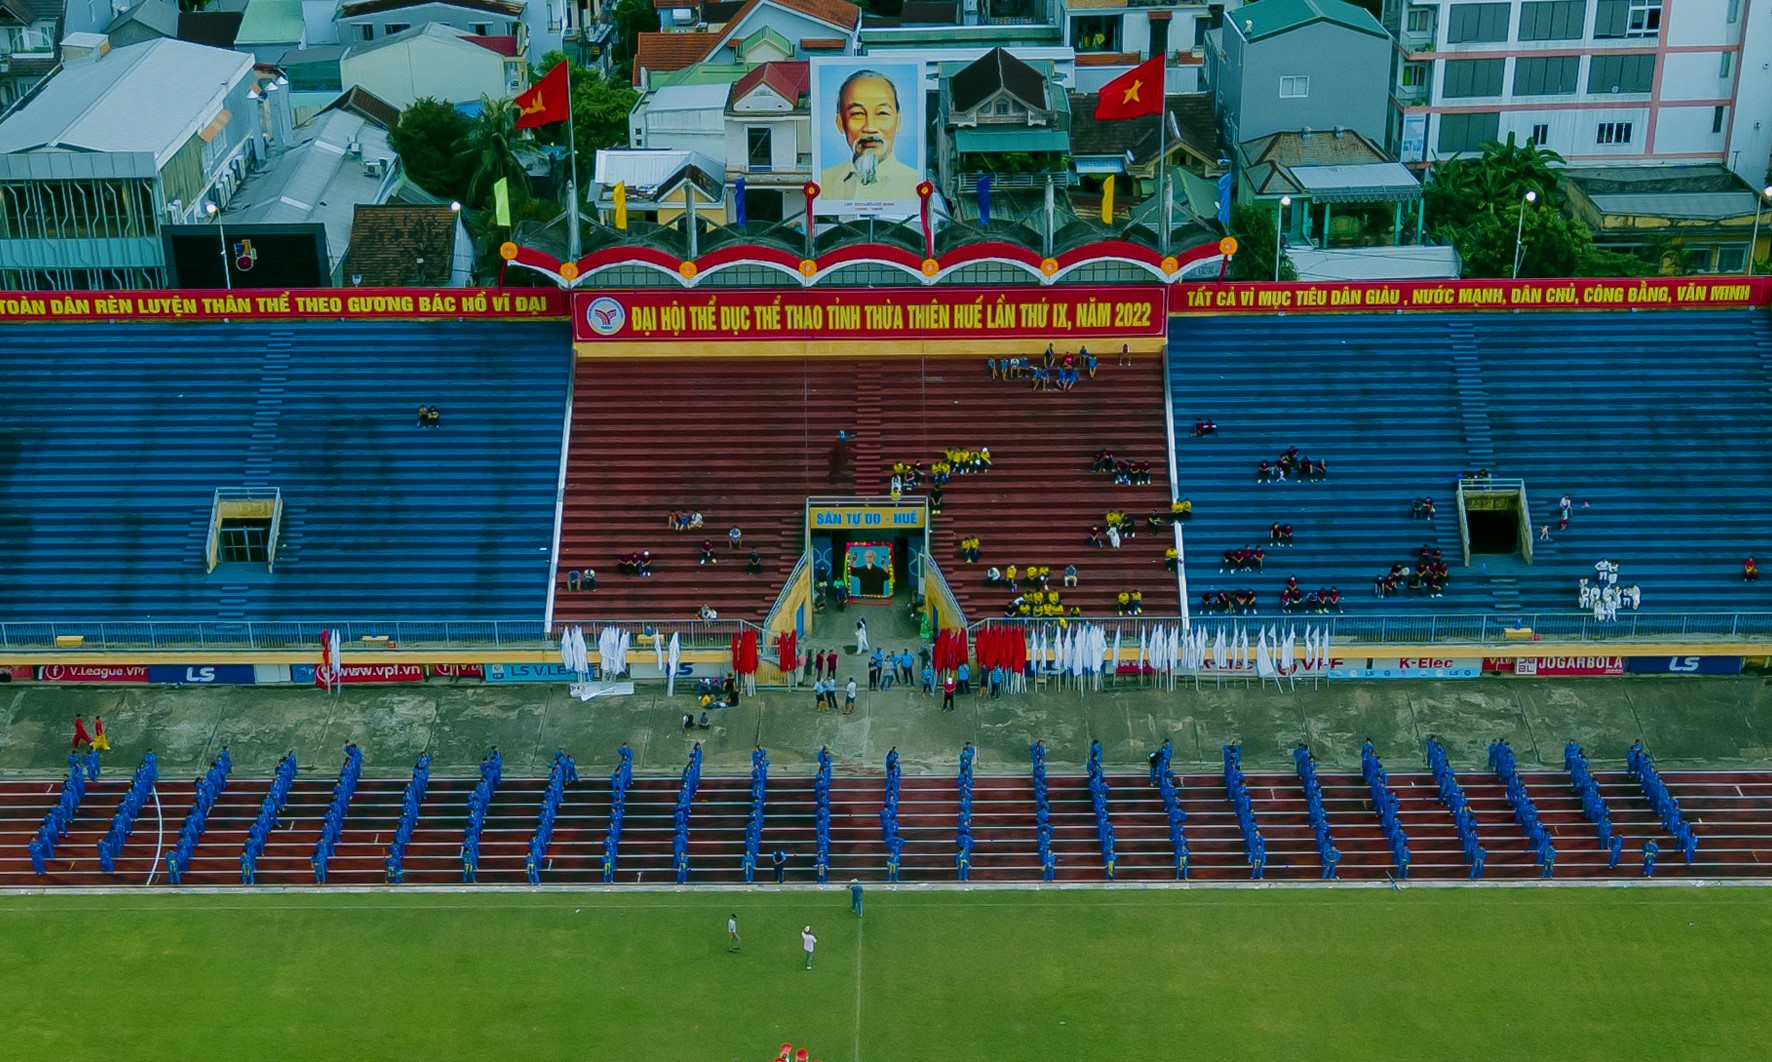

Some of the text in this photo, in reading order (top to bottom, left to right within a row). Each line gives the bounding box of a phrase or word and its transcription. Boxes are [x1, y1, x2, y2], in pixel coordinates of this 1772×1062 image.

[50, 296, 90, 314] DÂN
[94, 295, 133, 314] RÈN
[138, 295, 197, 316] LUYỆN
[201, 295, 251, 313] THÂN
[256, 291, 290, 313] THỂ
[295, 297, 342, 313] THEO
[347, 297, 413, 312] GƯƠNG
[419, 293, 456, 312] BÁC
[461, 290, 486, 312] HỒ
[492, 293, 510, 312] VĨ
[515, 296, 547, 315] ĐẠI
[1187, 286, 1213, 307] TẤT
[1216, 286, 1236, 307] CẢ
[1240, 286, 1255, 306] VÌ
[1258, 290, 1292, 309] MỤC
[1295, 287, 1327, 306] TIÊU
[1330, 286, 1362, 305] DÂN
[1365, 285, 1400, 305] GIÀU
[1412, 285, 1455, 304] NƯỚC
[1458, 288, 1507, 307] MẠNH,
[1511, 285, 1543, 304] DÂN
[1545, 282, 1579, 304] CHỦ,
[1583, 284, 1625, 303] CÔNG
[1627, 280, 1672, 304] BẰNG,
[1676, 282, 1707, 301] VĂN
[1709, 285, 1751, 302] MINH
[631, 306, 657, 336] ĐẠI
[660, 300, 686, 336] HỘI
[689, 295, 717, 331] THỂ
[720, 306, 750, 335] DỤC
[754, 295, 781, 330] THỂ
[785, 305, 823, 330] THAO
[826, 297, 860, 330] TỈNH
[865, 298, 904, 329] THỪA
[907, 298, 950, 329] THIÊN
[953, 295, 984, 329] HUẾ
[986, 294, 1016, 329] LẦN
[1020, 297, 1050, 328] THỨ
[1052, 303, 1072, 332] IX,
[1076, 296, 1111, 328] NĂM
[1115, 302, 1152, 327] 2022
[816, 511, 842, 525] SÂN
[846, 512, 862, 527] TỰ
[893, 509, 918, 524] HUẾ
[511, 666, 530, 676] LS
[1399, 658, 1453, 669] K-Elec
[1668, 656, 1700, 671] LS
[186, 666, 215, 682] LS
